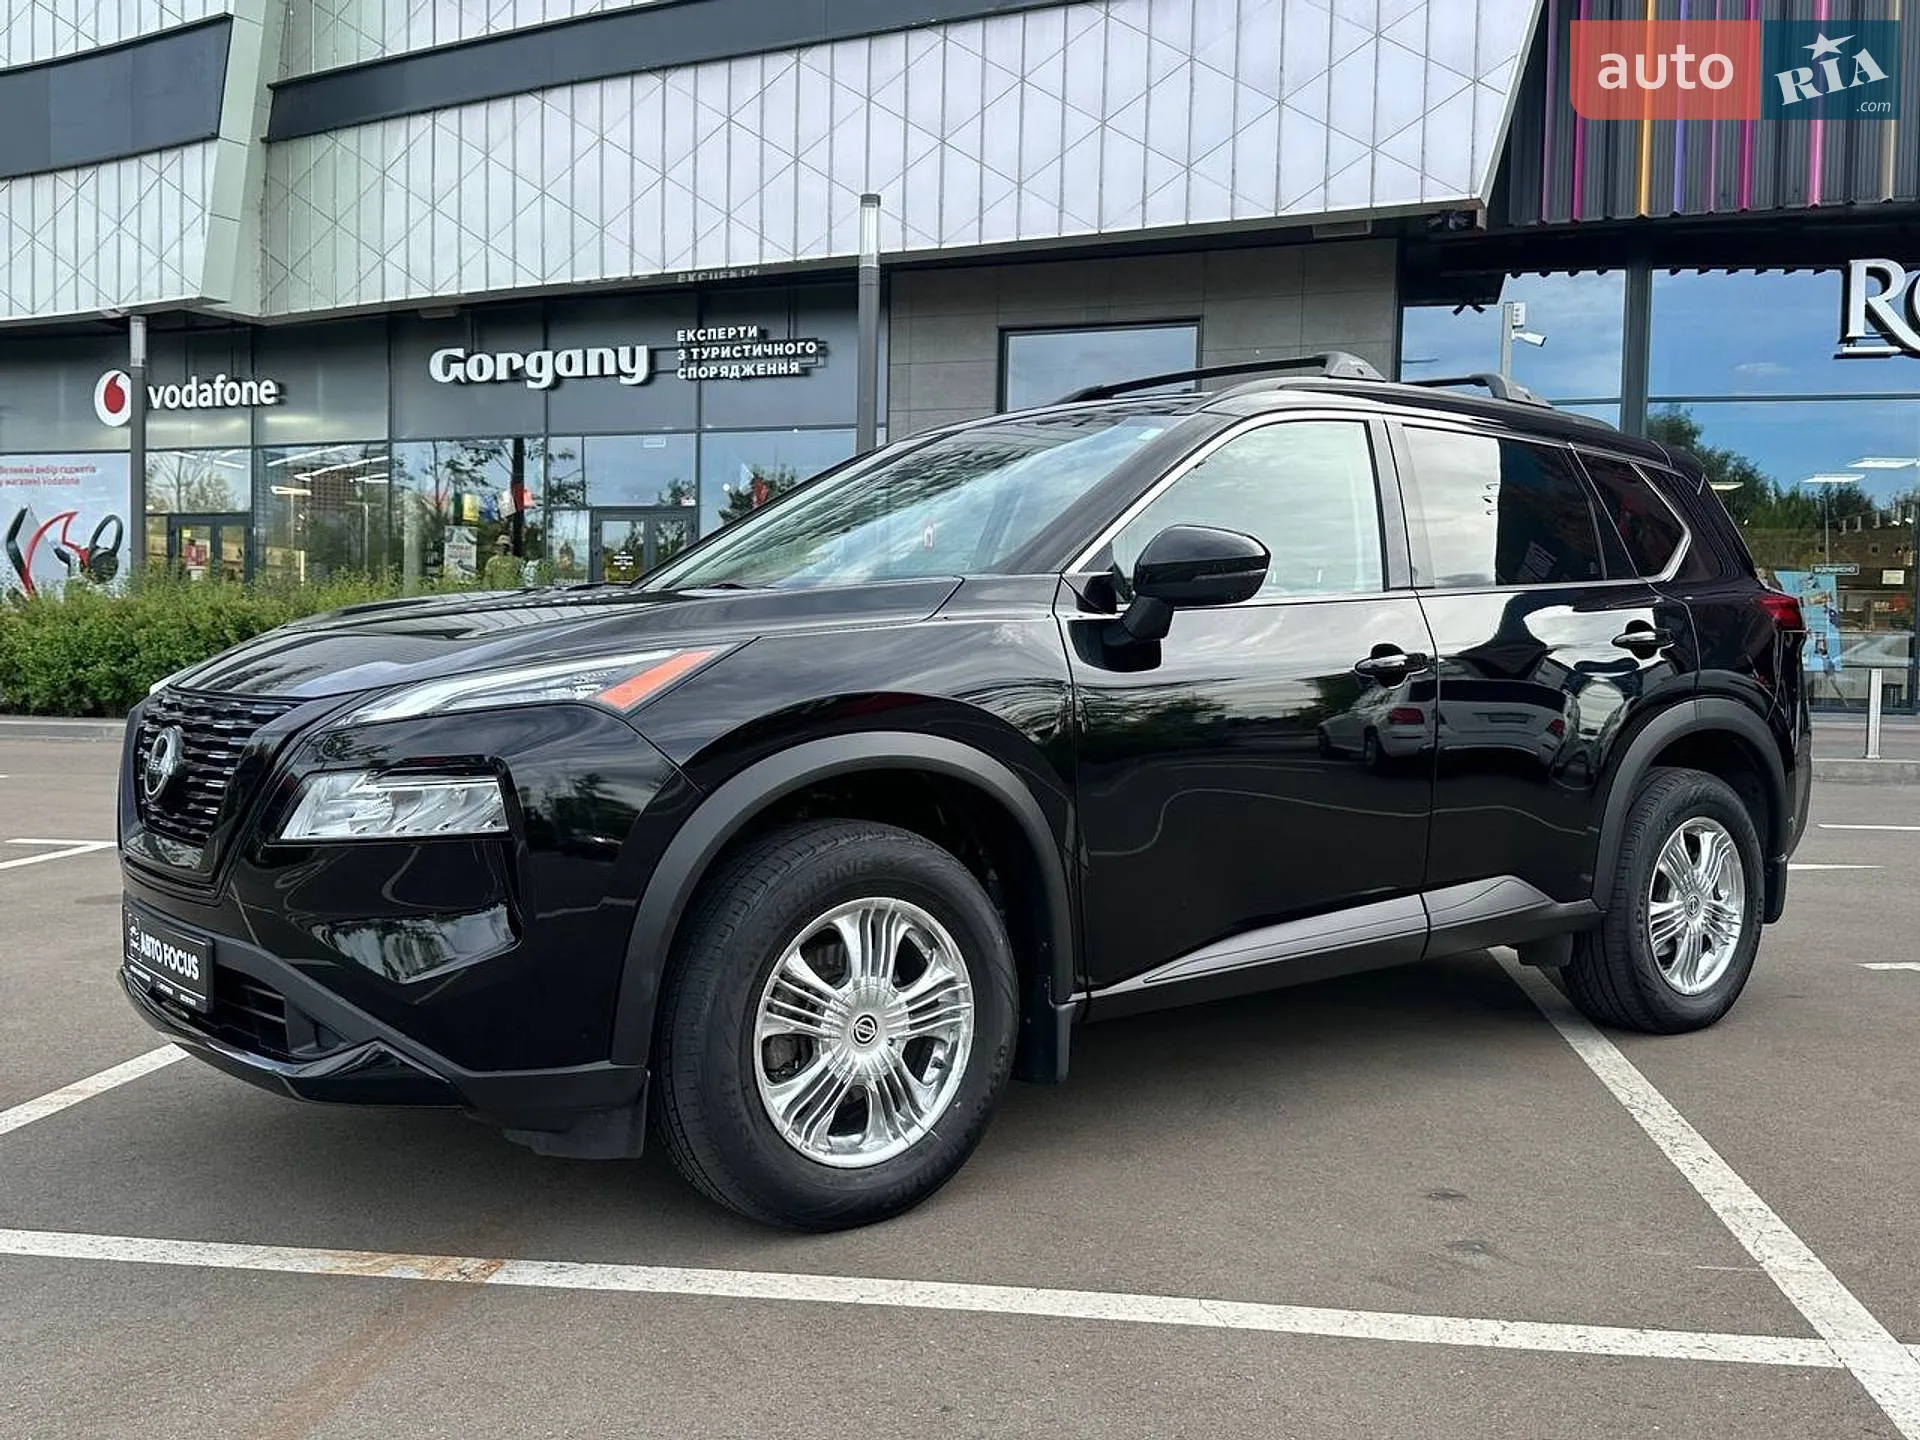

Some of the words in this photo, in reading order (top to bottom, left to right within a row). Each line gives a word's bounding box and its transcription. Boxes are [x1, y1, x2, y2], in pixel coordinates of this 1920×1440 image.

[1846, 258, 1920, 352] R
[676, 325, 758, 342] ЕКСПЕРТИ
[690, 341, 817, 360] ТУРИСТИЧНОГО
[428, 344, 650, 390] Gorgany
[676, 361, 800, 380] СПОРЯДЖЕННЯ
[146, 373, 277, 409] vodafone
[163, 943, 200, 981] FOCUS
